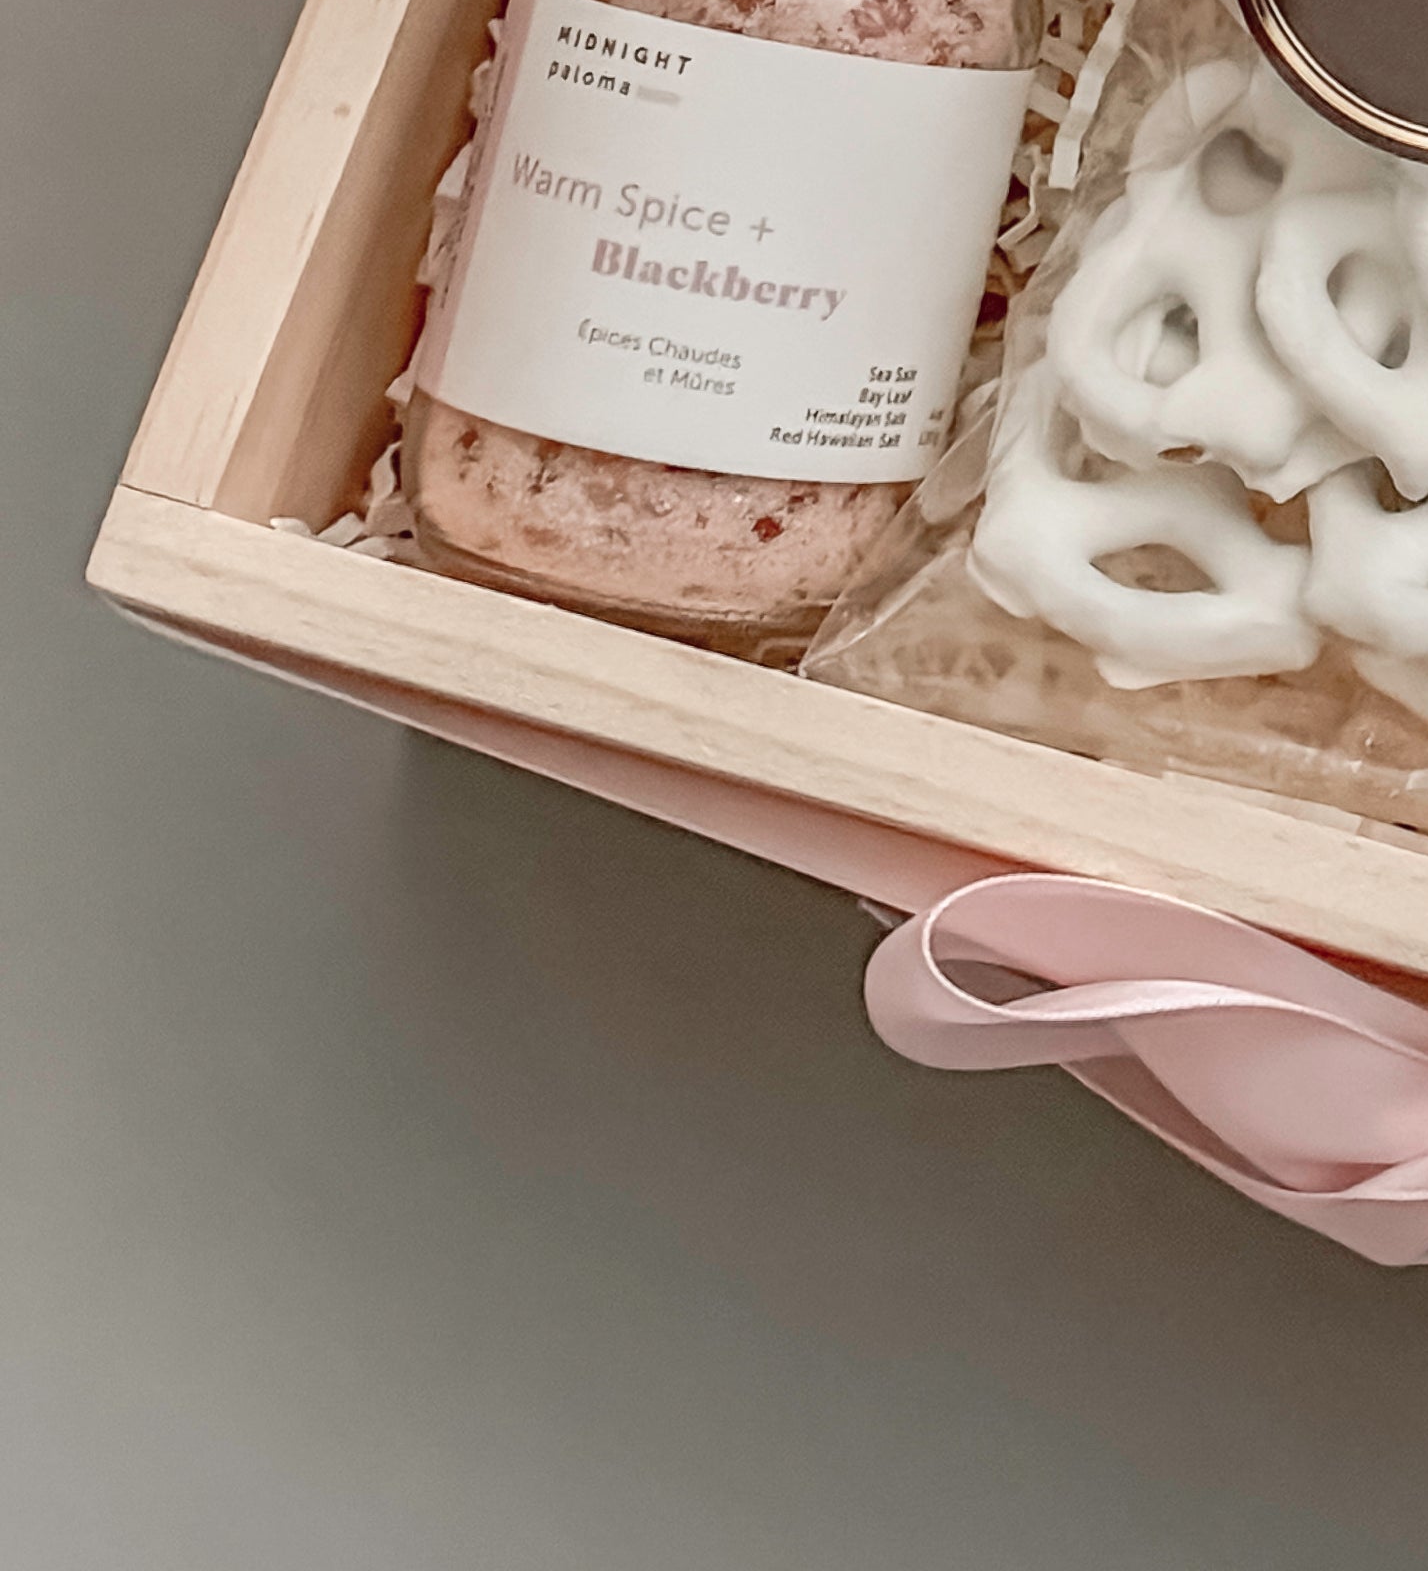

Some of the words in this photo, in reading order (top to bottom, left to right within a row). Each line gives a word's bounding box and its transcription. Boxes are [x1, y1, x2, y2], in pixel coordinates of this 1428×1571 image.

[557, 26, 692, 75] MIDNIGHT
[547, 60, 631, 96] paloma
[512, 153, 602, 210] Warm
[615, 182, 731, 236] Spice
[750, 216, 774, 243] +
[591, 237, 847, 322] Blackberry
[648, 336, 742, 370] Chaudes
[669, 368, 737, 396] Mûres
[768, 426, 803, 445] Red
